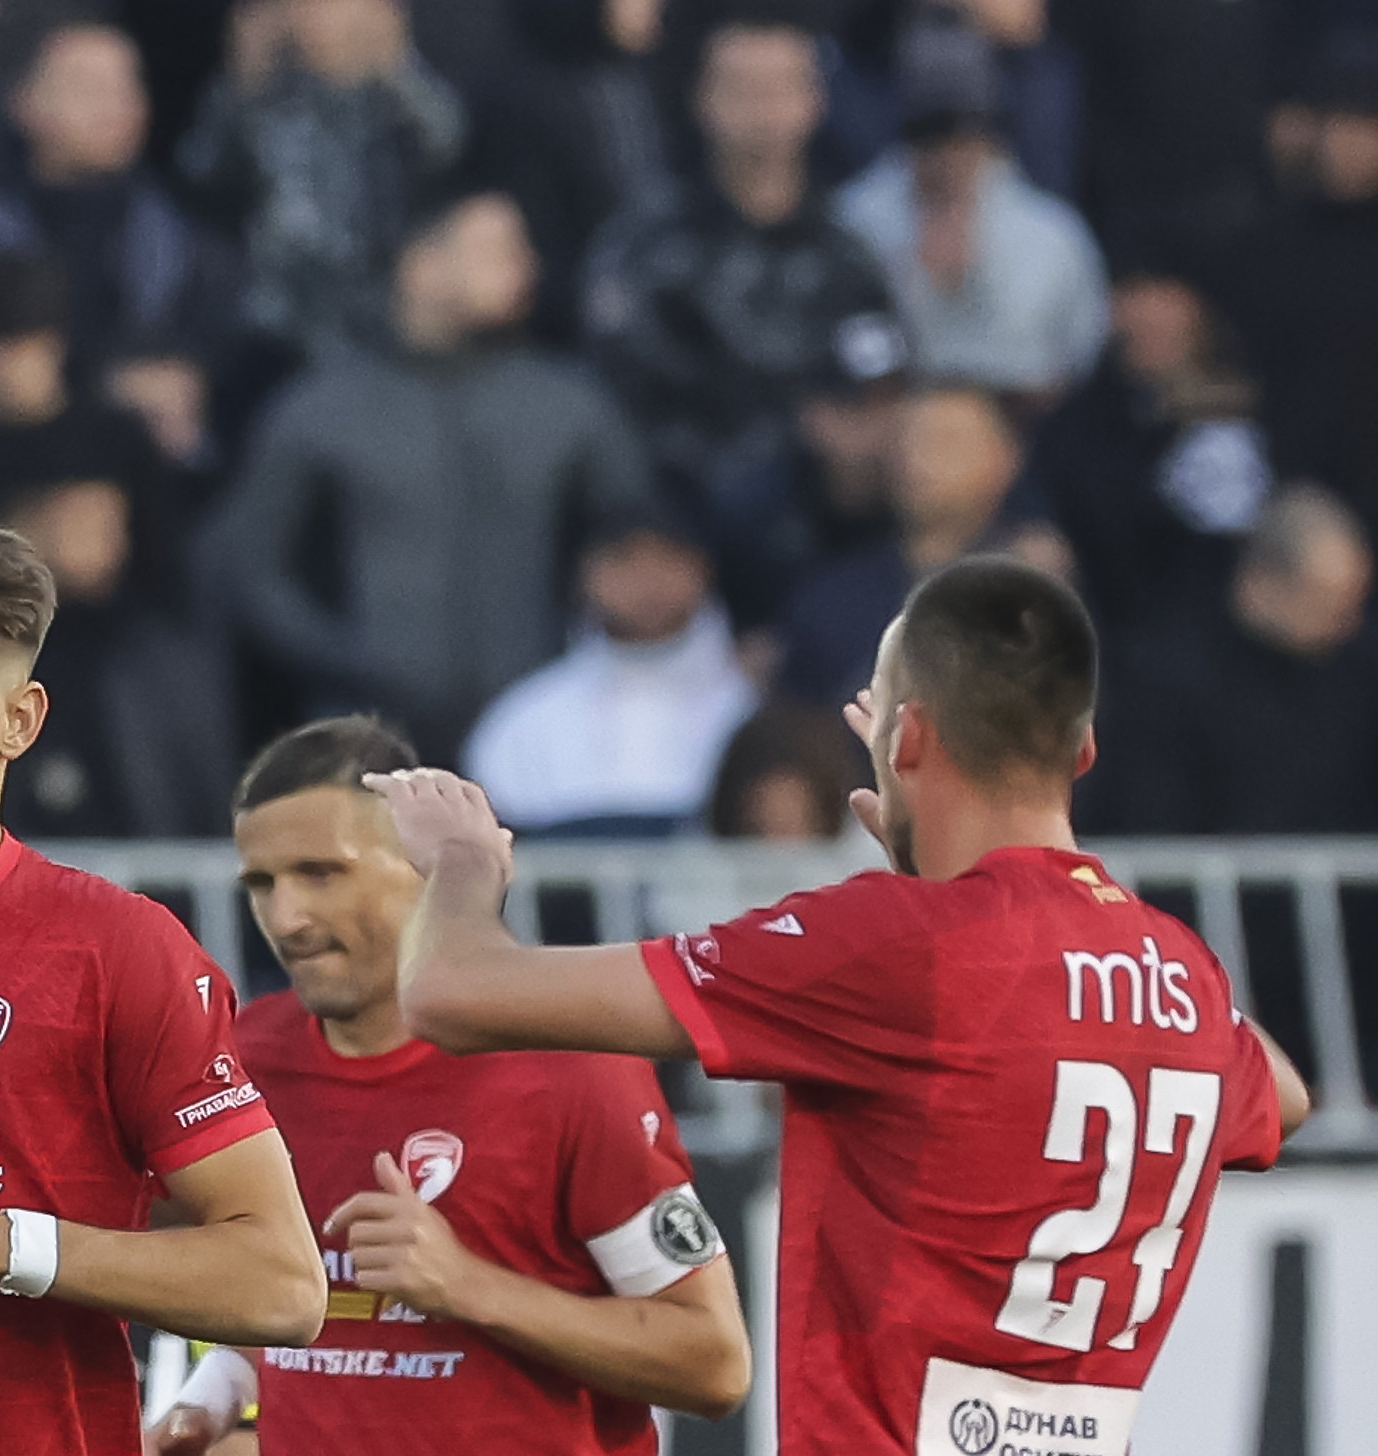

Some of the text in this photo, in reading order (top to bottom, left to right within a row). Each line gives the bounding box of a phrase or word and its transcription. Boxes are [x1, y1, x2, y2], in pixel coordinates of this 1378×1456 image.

[1062, 936, 1199, 1035] mts
[994, 1058, 1222, 1353] 27
[1004, 1405, 1099, 1441] ДУНАВ
